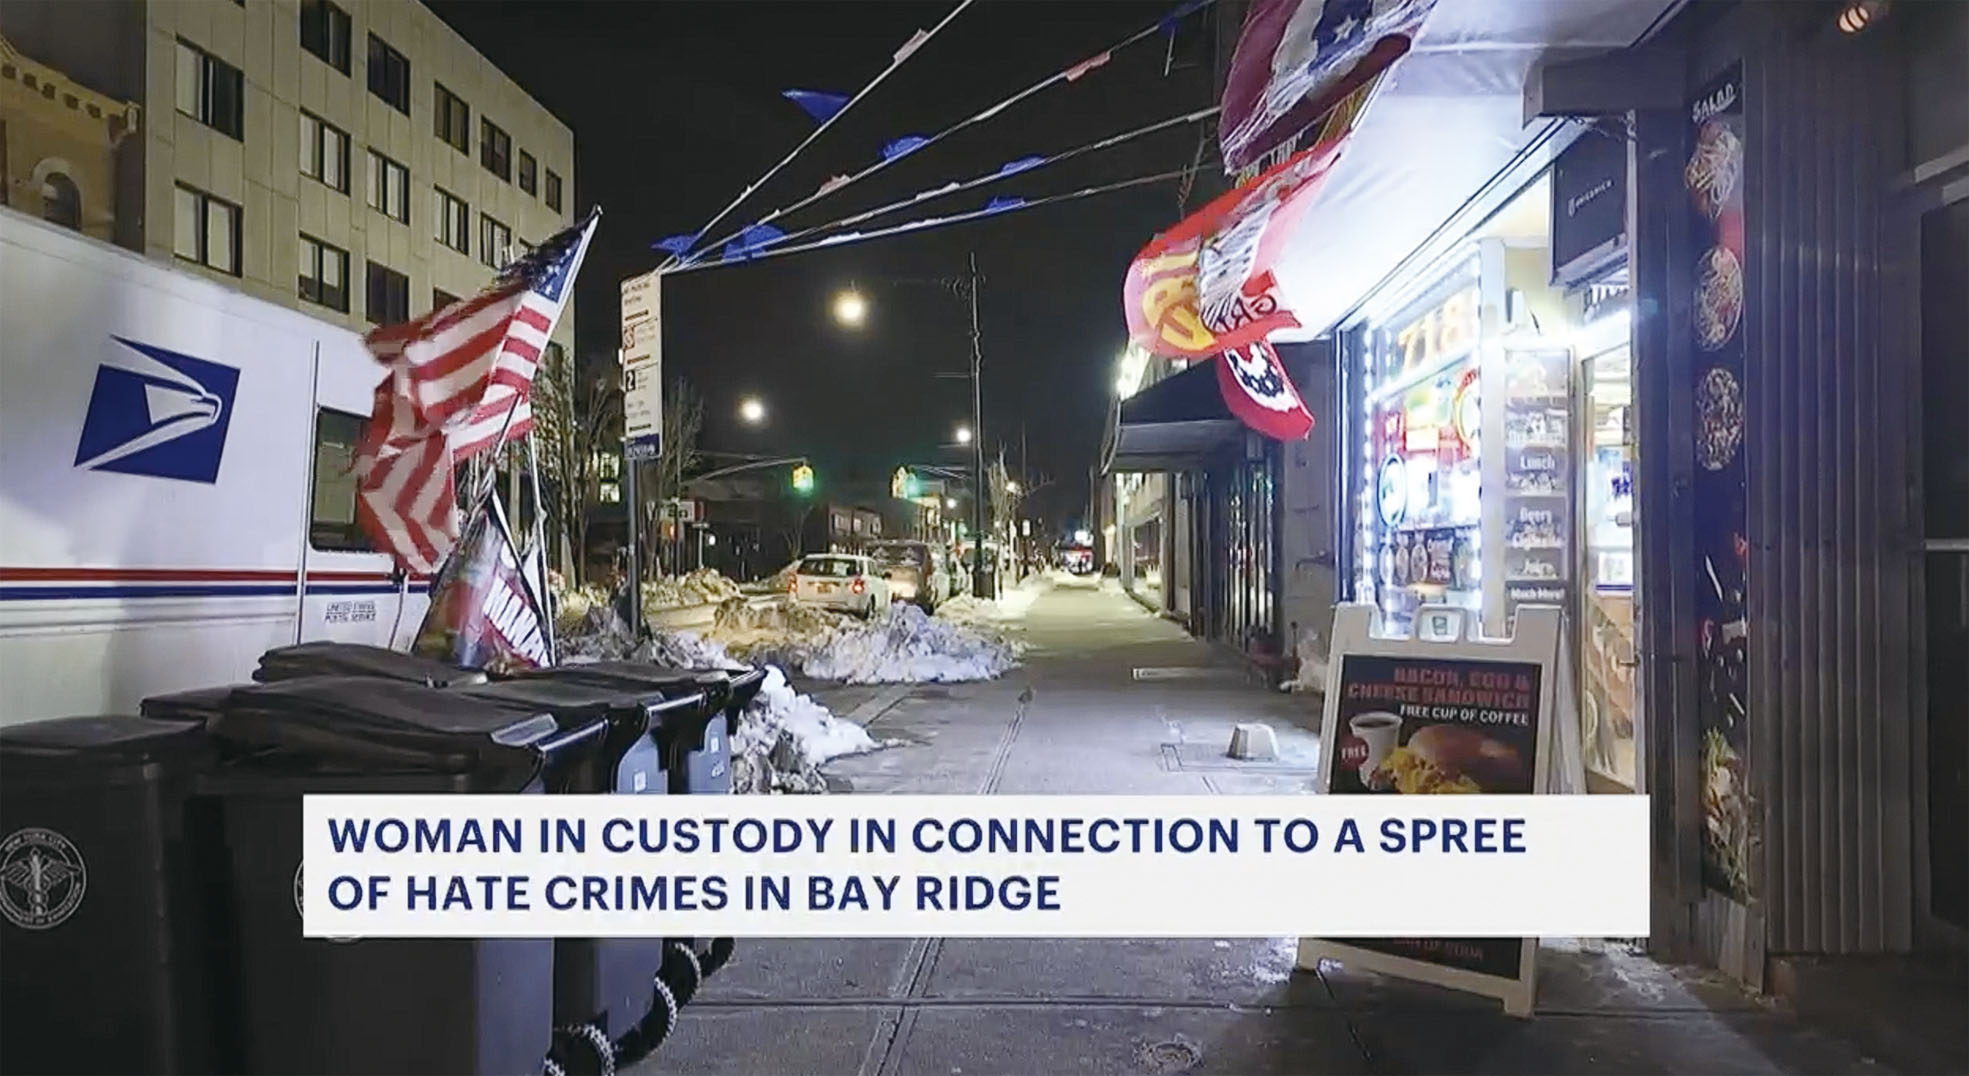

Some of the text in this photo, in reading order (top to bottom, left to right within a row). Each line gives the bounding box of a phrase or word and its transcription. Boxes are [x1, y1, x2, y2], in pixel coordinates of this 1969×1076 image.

[1347, 682, 1530, 709] CHEESE SANDWICH
[1400, 703, 1530, 726] FREE CUP OF COFFEE
